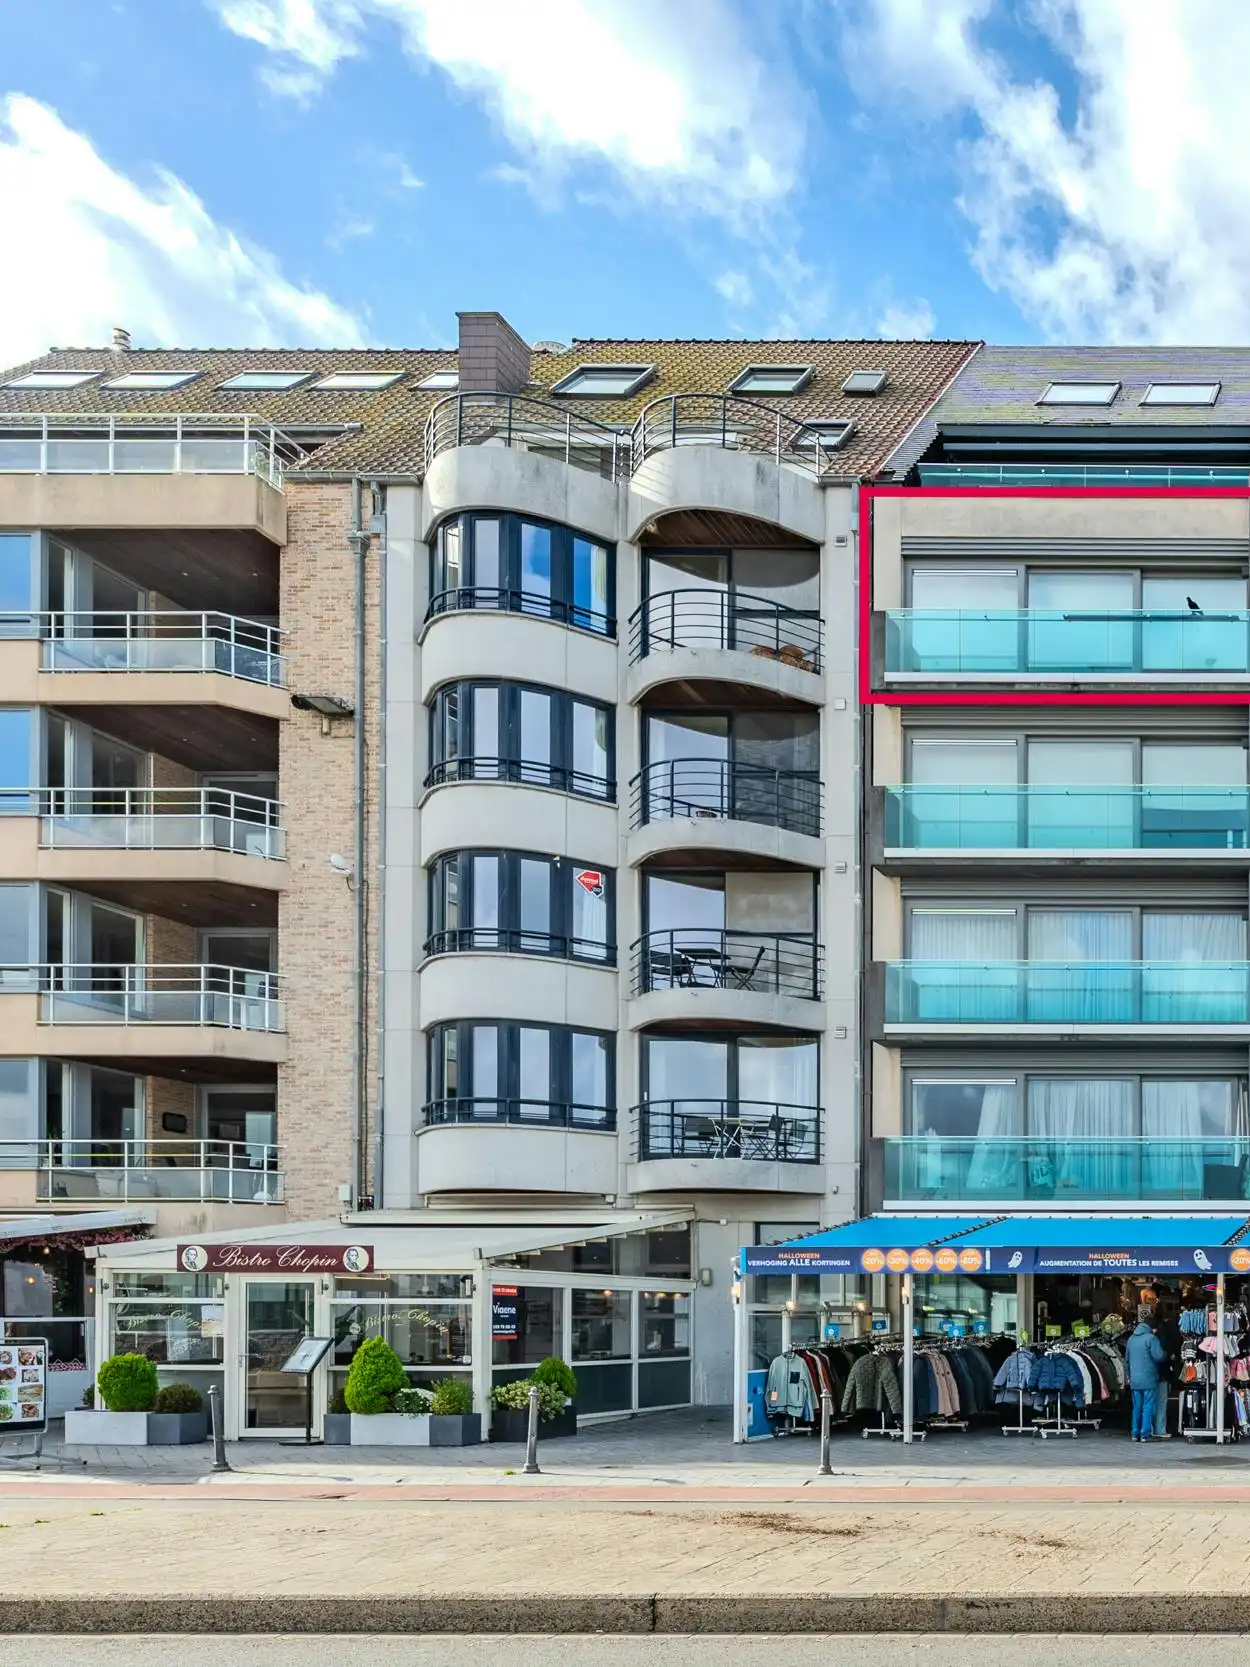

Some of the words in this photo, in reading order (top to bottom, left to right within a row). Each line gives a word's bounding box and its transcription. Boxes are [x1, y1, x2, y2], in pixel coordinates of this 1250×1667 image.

[213, 1245, 273, 1267] Bistro
[276, 1245, 339, 1272] Chopin
[789, 1258, 811, 1266] ALLE
